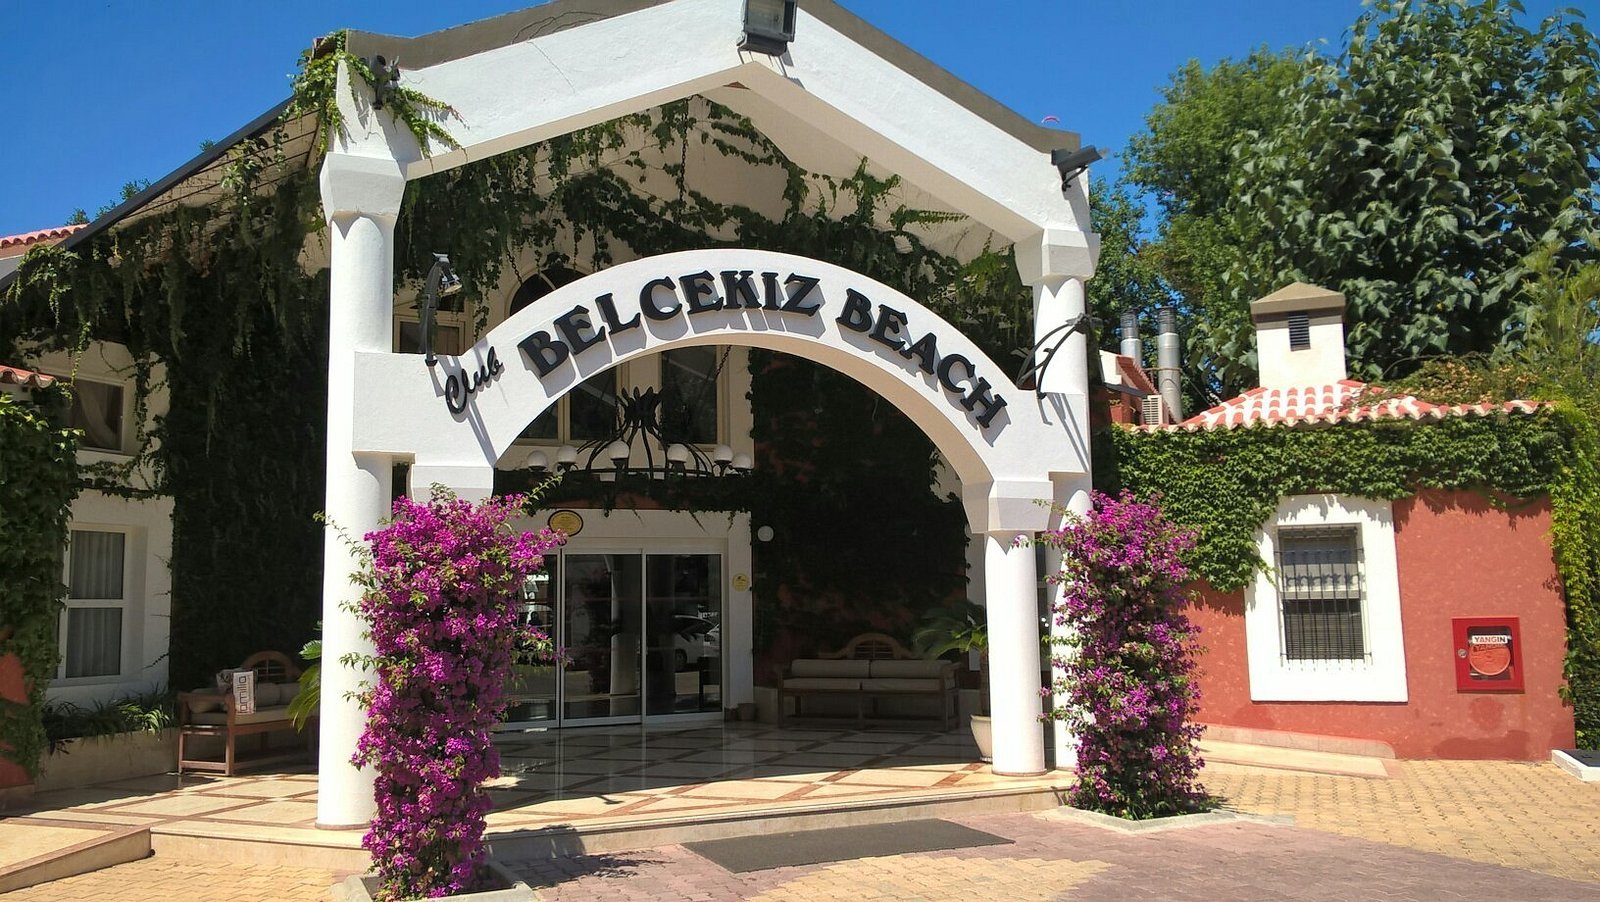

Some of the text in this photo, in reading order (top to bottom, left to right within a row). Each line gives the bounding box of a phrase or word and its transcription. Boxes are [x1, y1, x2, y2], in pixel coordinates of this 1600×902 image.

[445, 270, 1008, 428] Club BELCEKIZ BEACH
